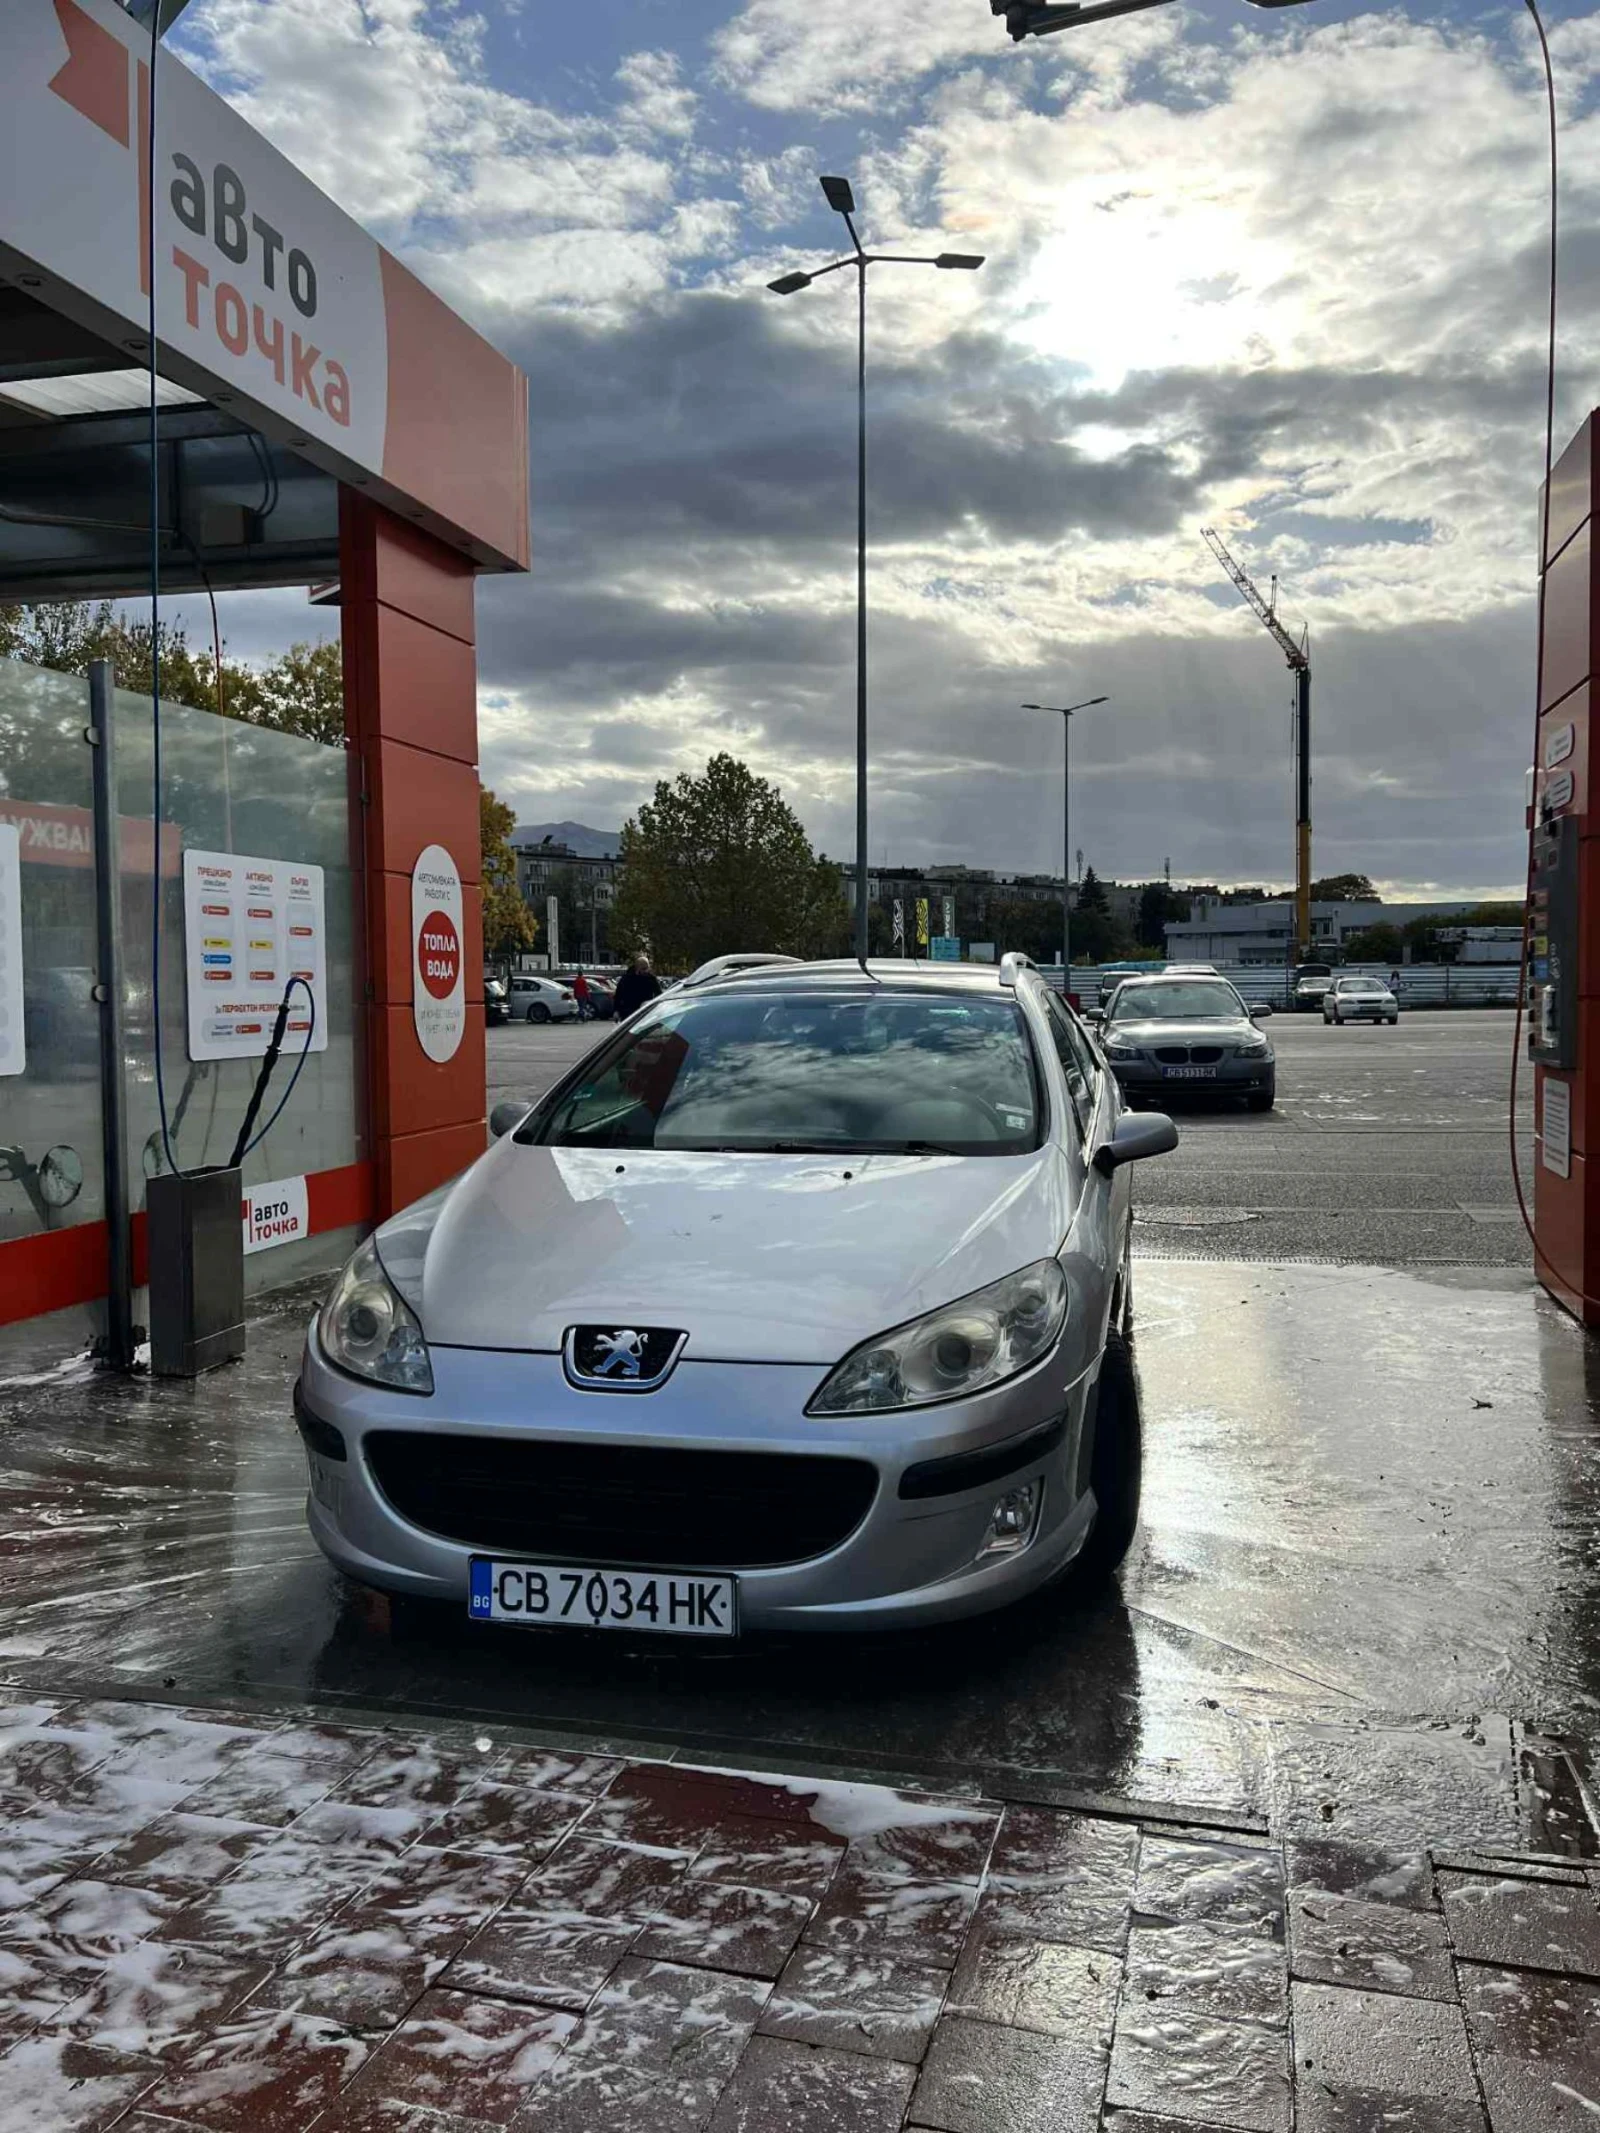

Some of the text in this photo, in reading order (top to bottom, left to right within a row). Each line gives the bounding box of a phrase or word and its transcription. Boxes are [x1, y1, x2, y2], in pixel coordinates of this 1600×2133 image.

[172, 245, 351, 428] точка
[424, 933, 456, 951] ТОПЛА
[427, 959, 454, 980] ВОДА
[254, 1201, 289, 1222] авто
[255, 1216, 298, 1241] точка
[473, 1595, 490, 1609] BG
